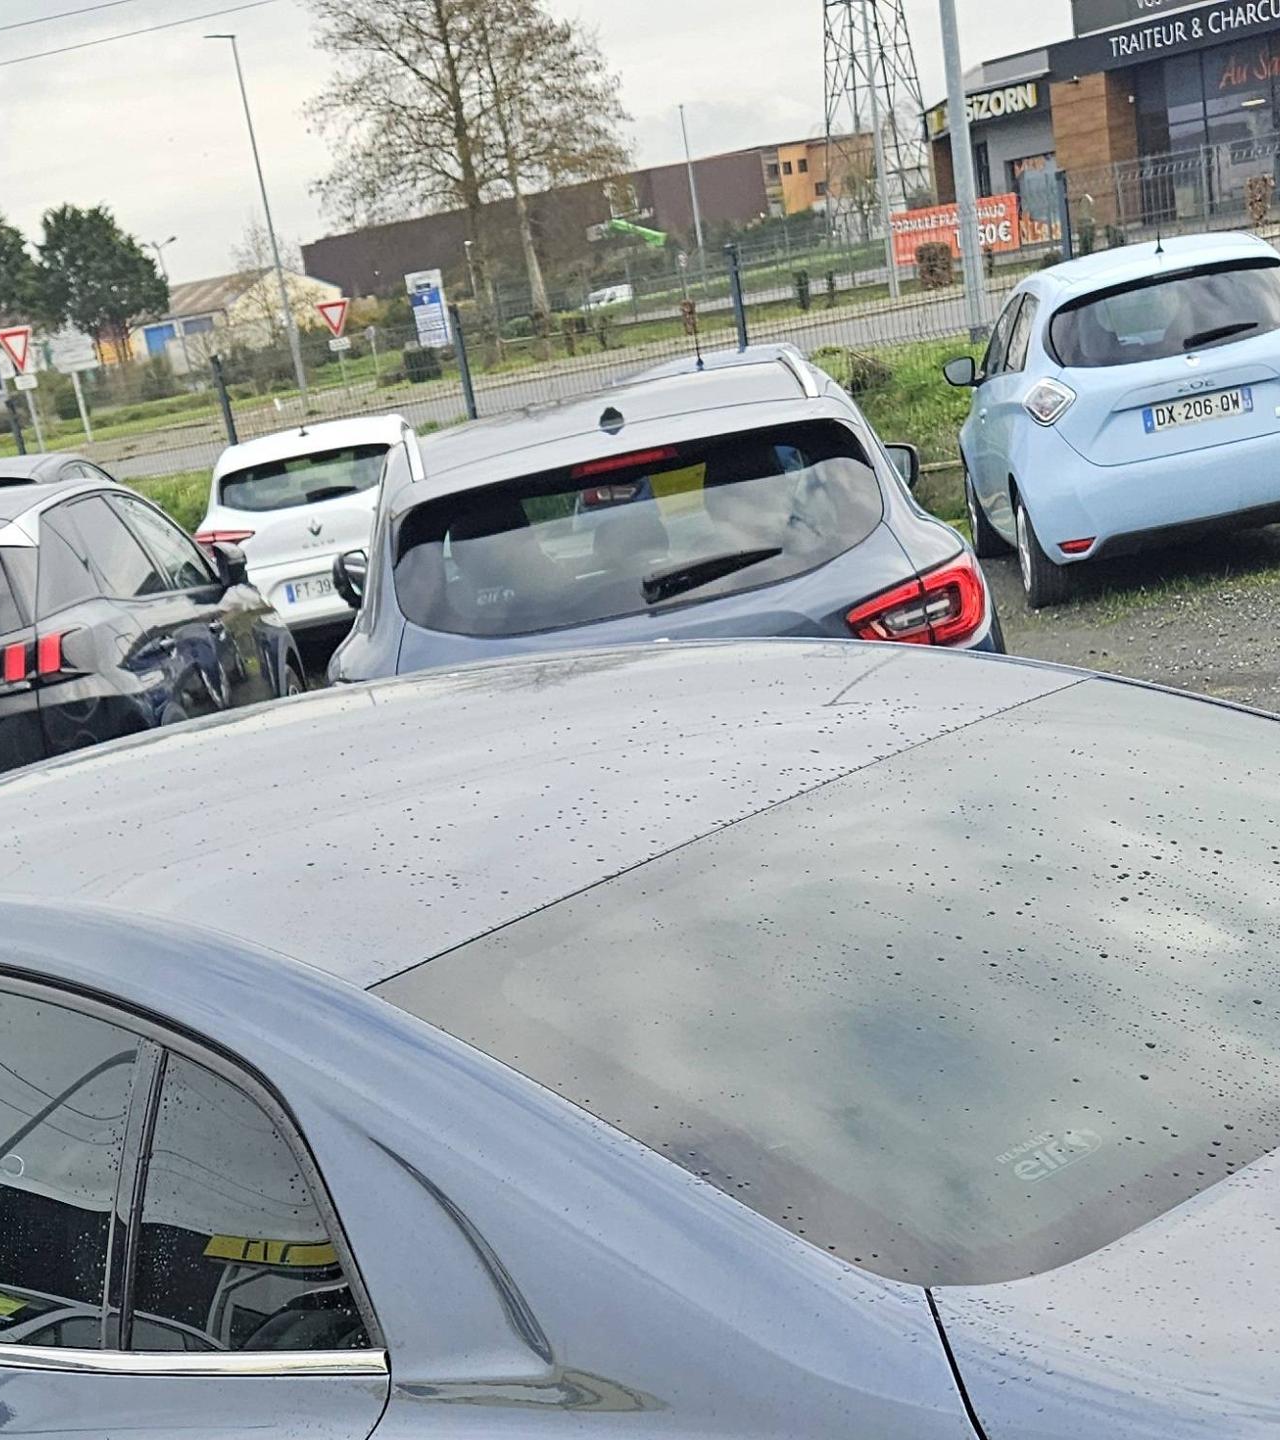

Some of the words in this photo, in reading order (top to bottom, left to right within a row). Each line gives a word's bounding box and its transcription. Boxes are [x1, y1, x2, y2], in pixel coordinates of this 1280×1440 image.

[1109, 22, 1188, 57] TRAITEUR
[1191, 17, 1204, 39] &
[1219, 54, 1248, 89] Au
